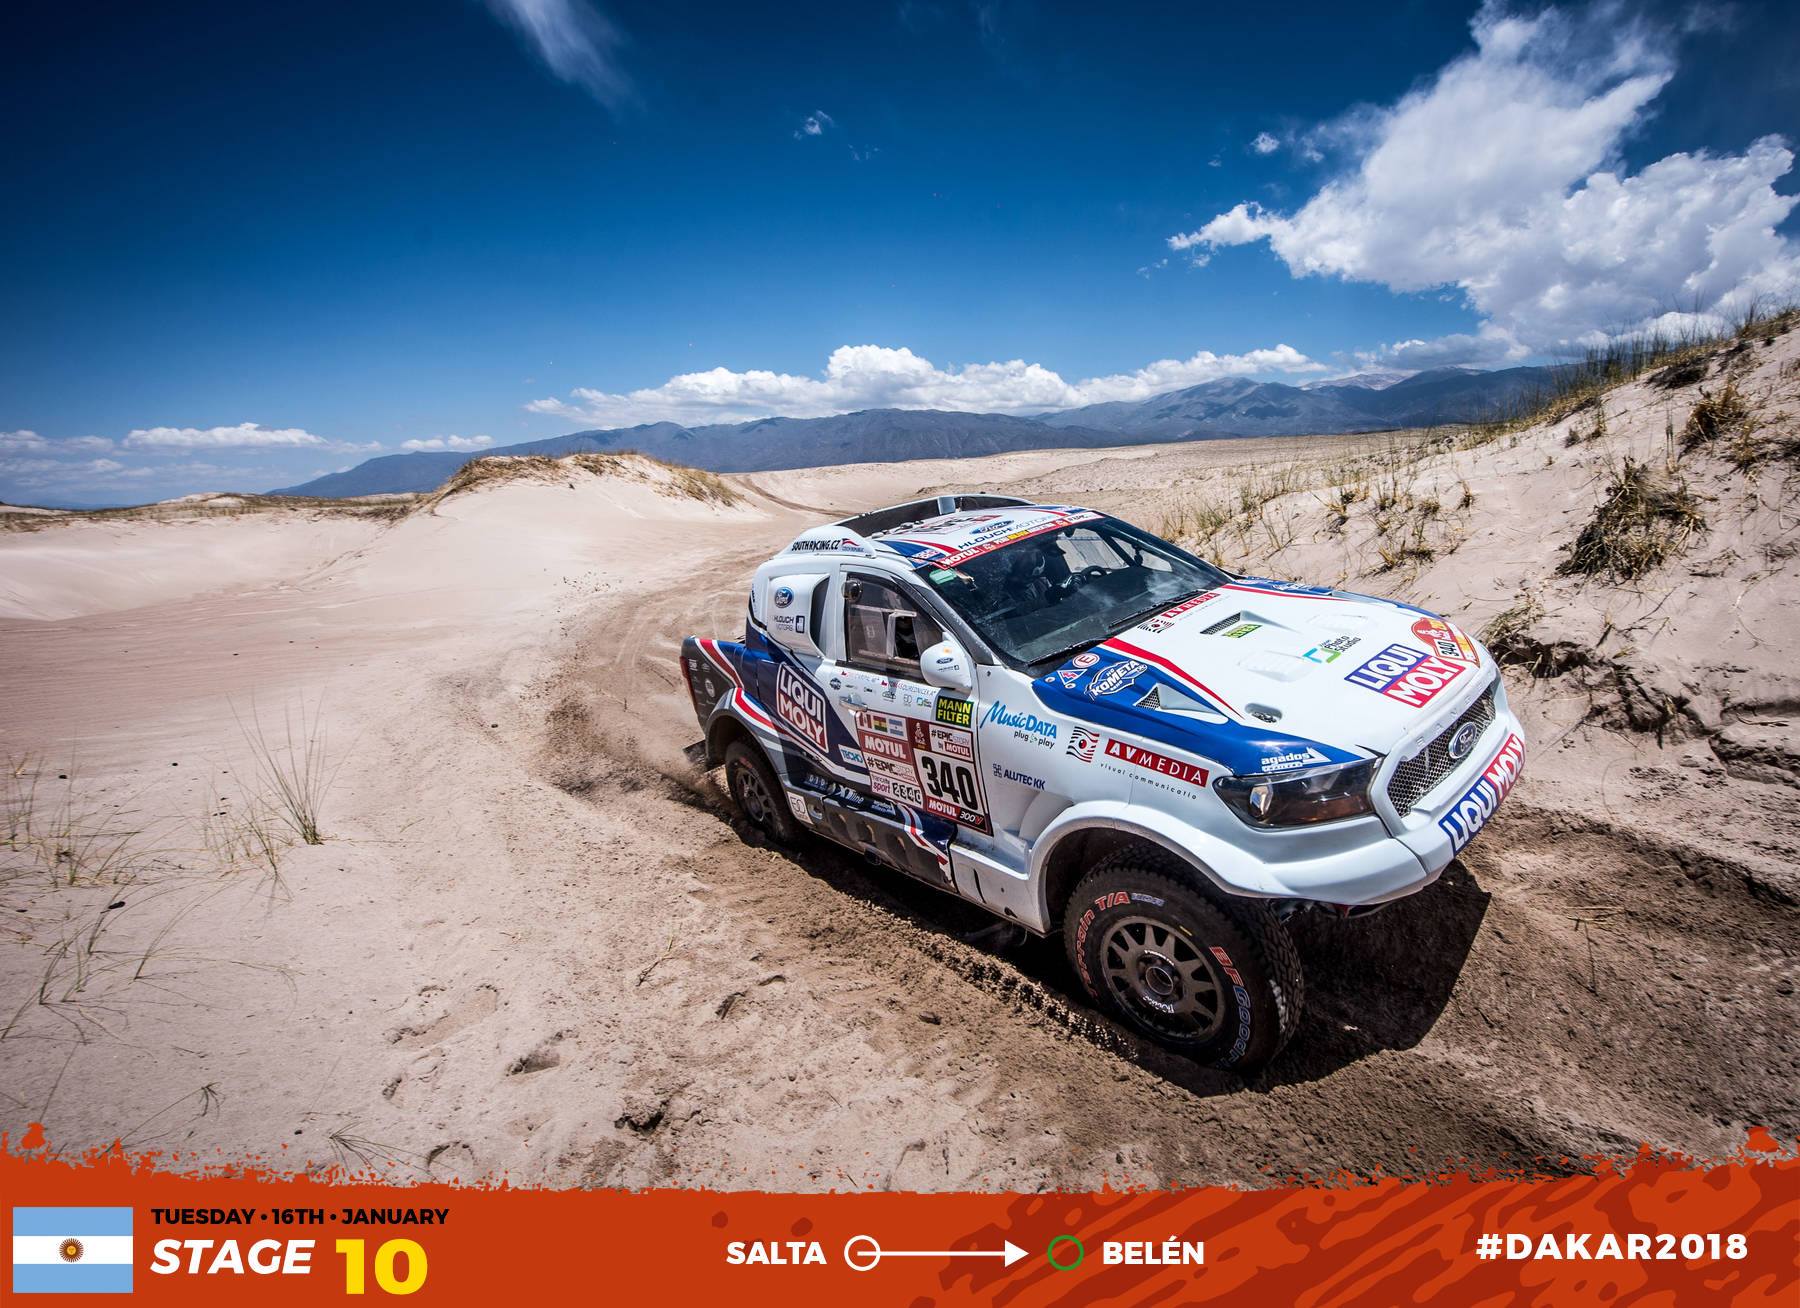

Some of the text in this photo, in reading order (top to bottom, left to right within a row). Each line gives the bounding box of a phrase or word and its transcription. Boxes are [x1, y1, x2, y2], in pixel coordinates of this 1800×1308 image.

[958, 527, 1012, 550] HLOUCH
[940, 547, 979, 566] MOTUL
[1350, 644, 1426, 688] LIQUI
[1092, 660, 1140, 696] KOMETA
[1385, 657, 1466, 705] MOLY
[779, 668, 821, 722] LIQUI
[938, 699, 972, 714] MANN
[780, 693, 824, 745] MOLY
[937, 710, 970, 726] FILTER
[980, 701, 1057, 739] MusicDATA
[864, 735, 907, 760] MOTUL
[1014, 730, 1029, 742] plug
[1038, 737, 1055, 749] play
[945, 744, 970, 756] MOTUL
[1260, 751, 1312, 766] agados
[1100, 763, 1126, 775] visual
[1486, 735, 1524, 798] MOLY
[873, 782, 891, 794] sport
[921, 756, 978, 811] 340
[1003, 768, 1046, 790] ALUTEC KK
[928, 799, 983, 824] MOTUL 300V
[1442, 780, 1497, 851] LIQUI
[1095, 891, 1131, 912] T/A
